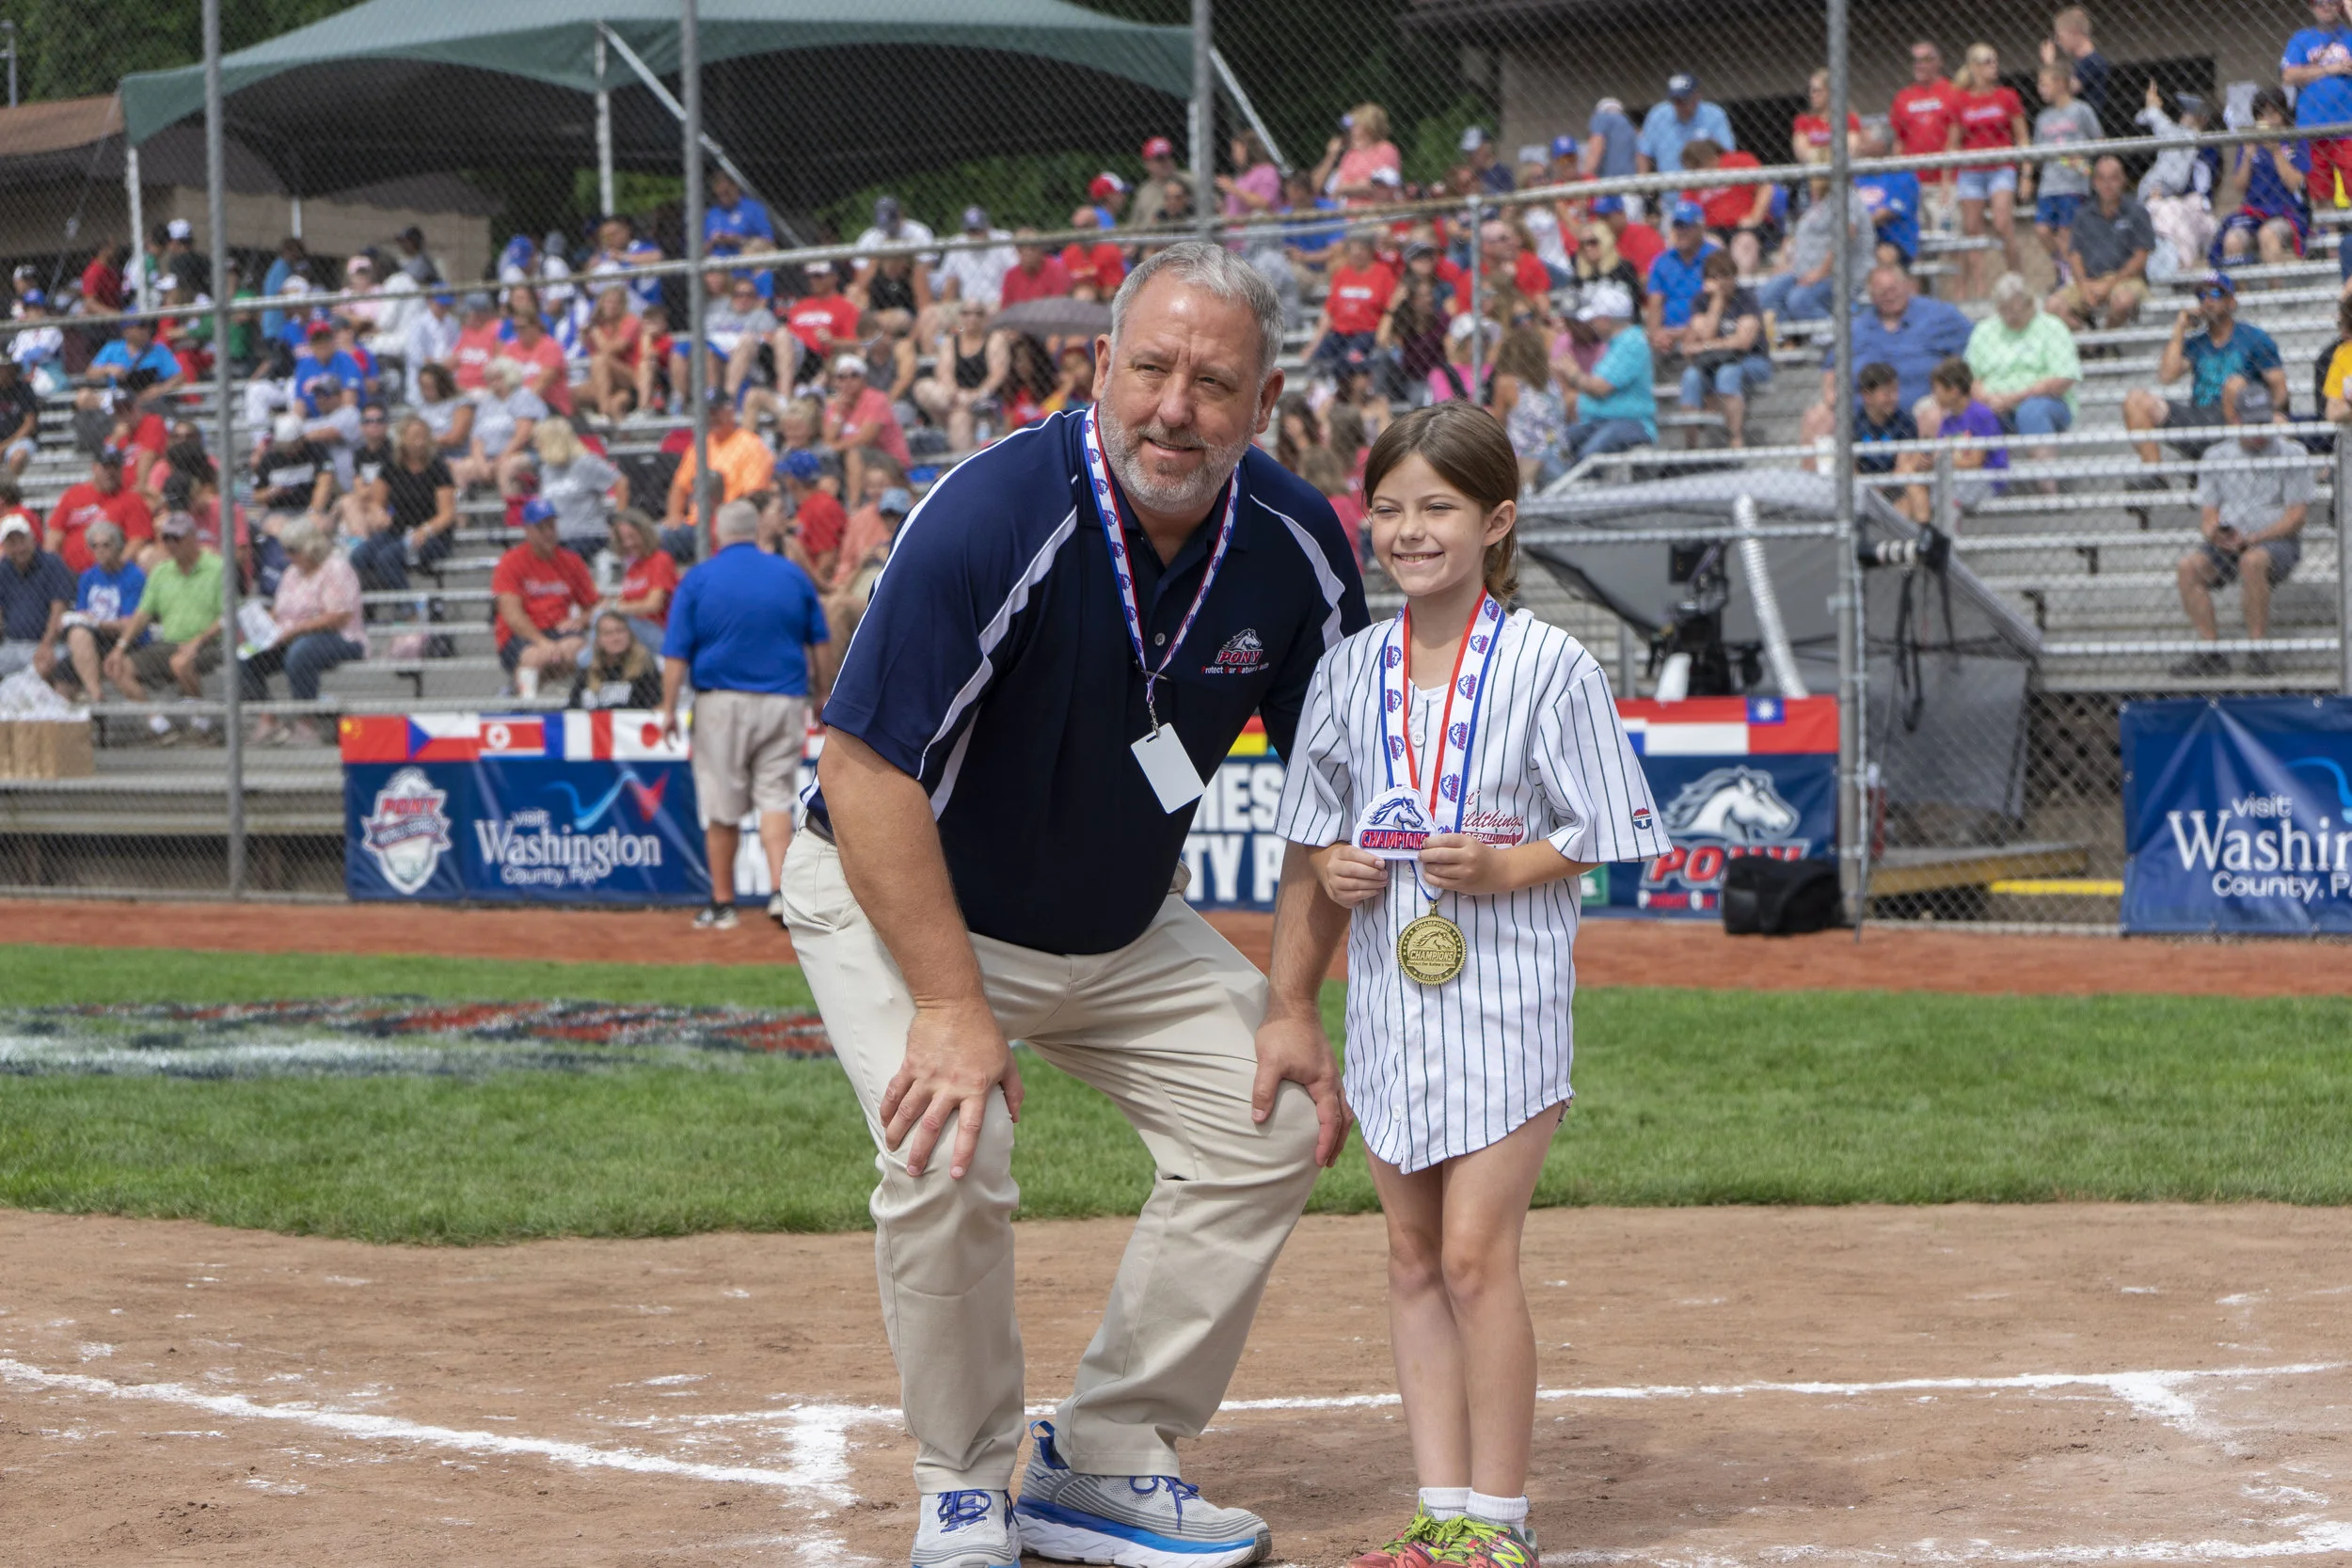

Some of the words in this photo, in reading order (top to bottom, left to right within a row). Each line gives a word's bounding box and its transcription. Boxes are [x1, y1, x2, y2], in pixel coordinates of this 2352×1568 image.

[1217, 650, 1262, 664] PONY
[1200, 665, 1224, 674] Protect
[1225, 665, 1236, 674] Our
[1466, 673, 1477, 701] PONY
[1457, 721, 1469, 752] PONY
[1449, 773, 1460, 803] PONY
[380, 797, 438, 816] PONY
[2232, 791, 2294, 818] visit
[514, 809, 549, 827] visit
[1462, 809, 1524, 834] ildthings
[474, 818, 662, 878] Washington
[2329, 872, 2352, 898] P
[1414, 921, 1453, 932] CHAMPIONS
[1410, 949, 1454, 961] CHAMPIONS
[1419, 973, 1443, 981] LEAGUE
